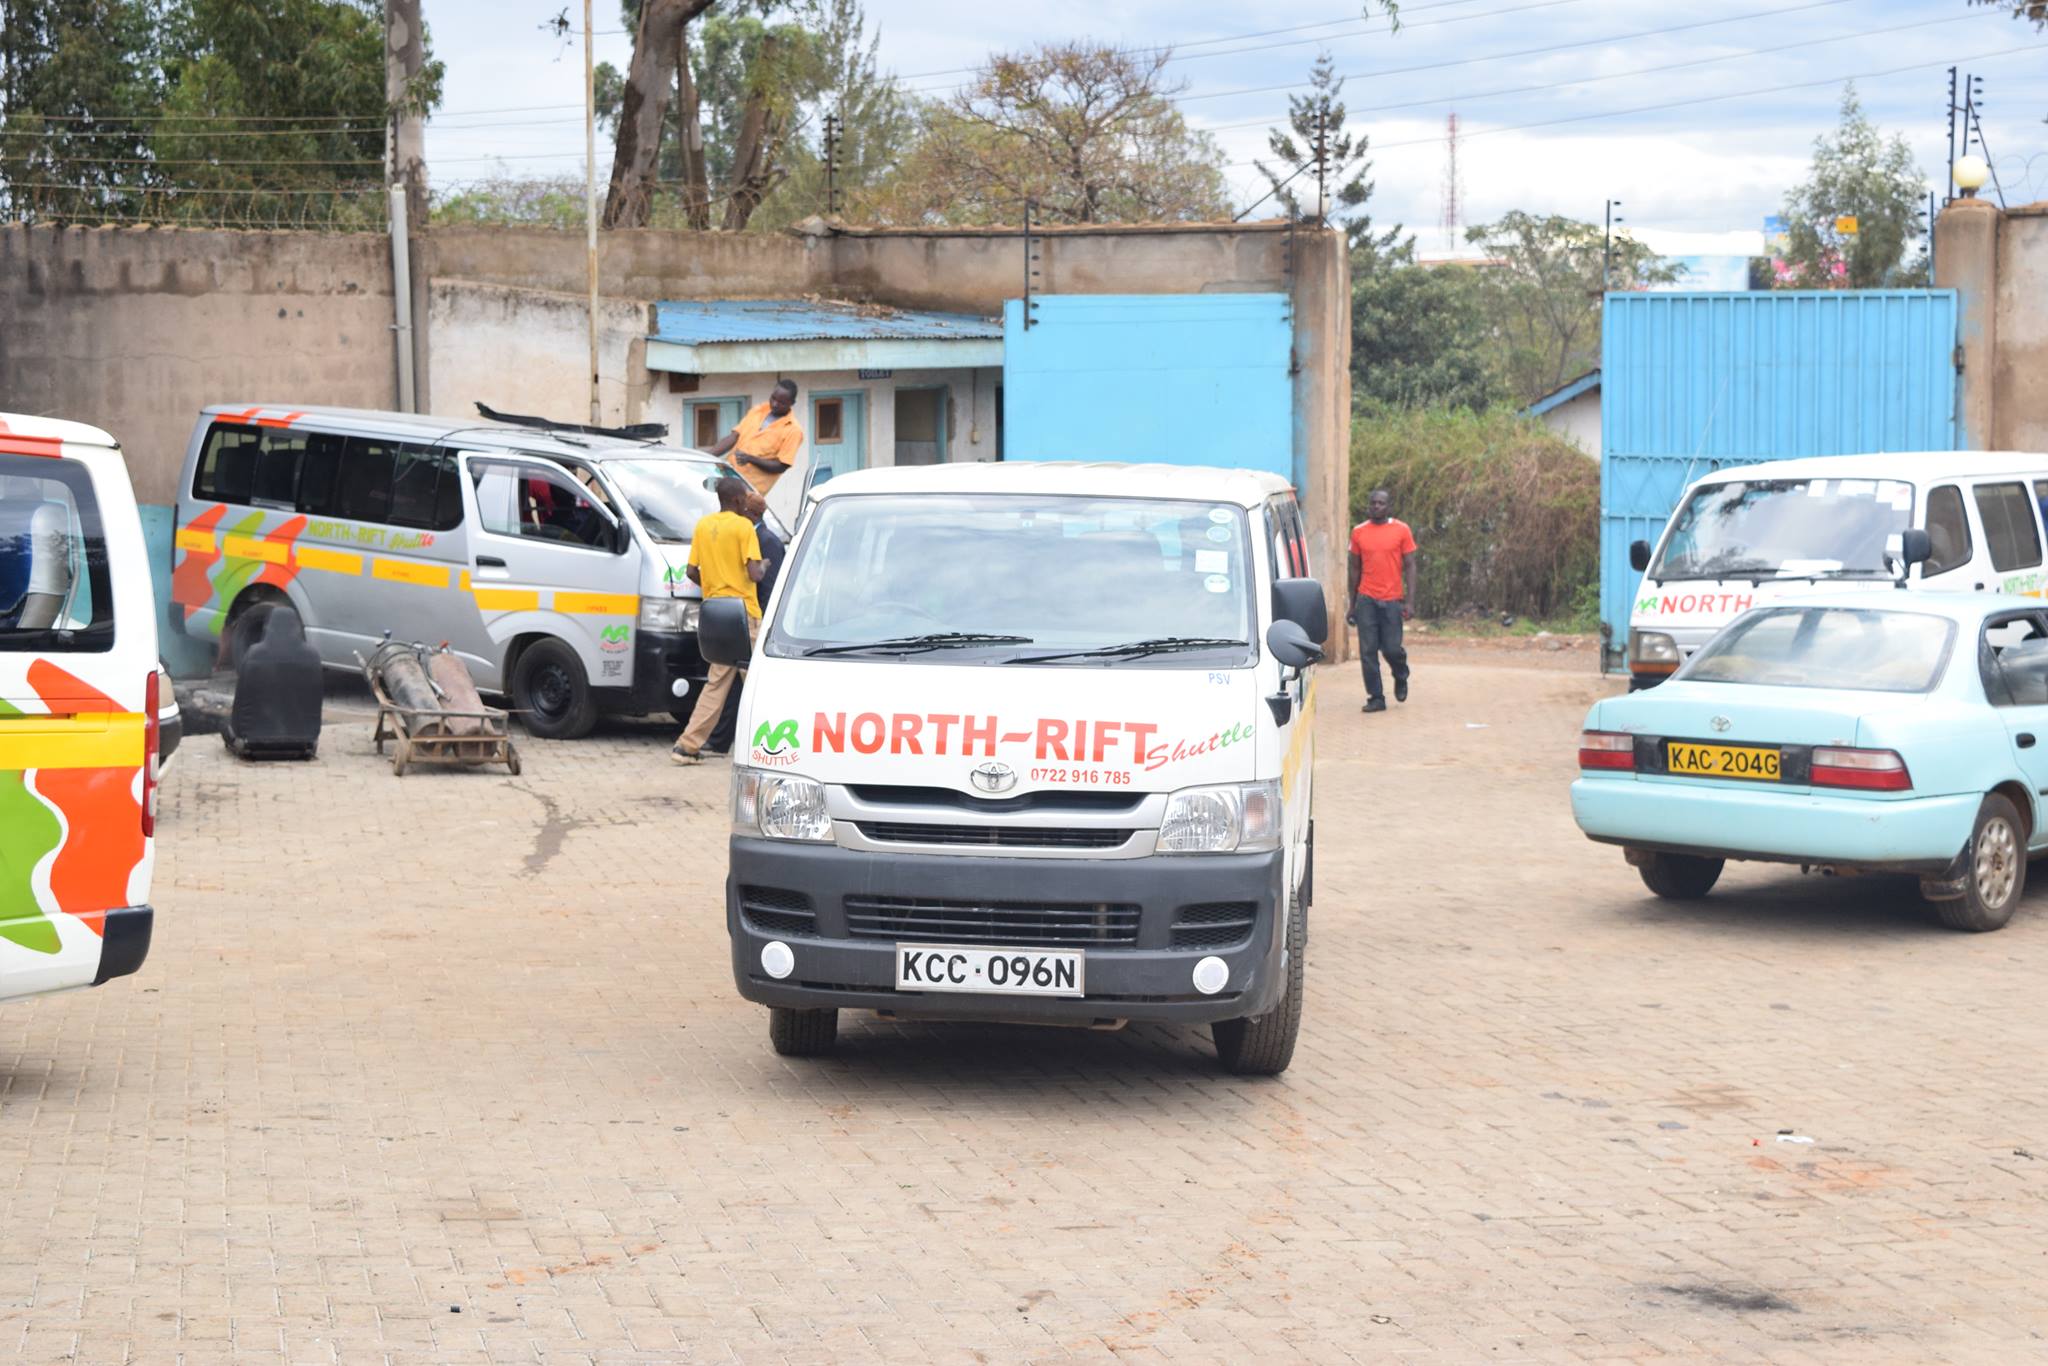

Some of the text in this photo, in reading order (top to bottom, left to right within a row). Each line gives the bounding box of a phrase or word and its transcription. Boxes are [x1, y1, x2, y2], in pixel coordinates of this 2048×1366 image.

[1660, 594, 1753, 614] NORTH
[1208, 672, 1230, 685] PSV
[1144, 721, 1256, 771] Shuttle
[752, 749, 800, 766] SHUTTLE
[1671, 747, 1779, 775] KAC 204G
[1031, 768, 1131, 785] 0722 916 785
[903, 952, 1075, 988] KCC 096N
